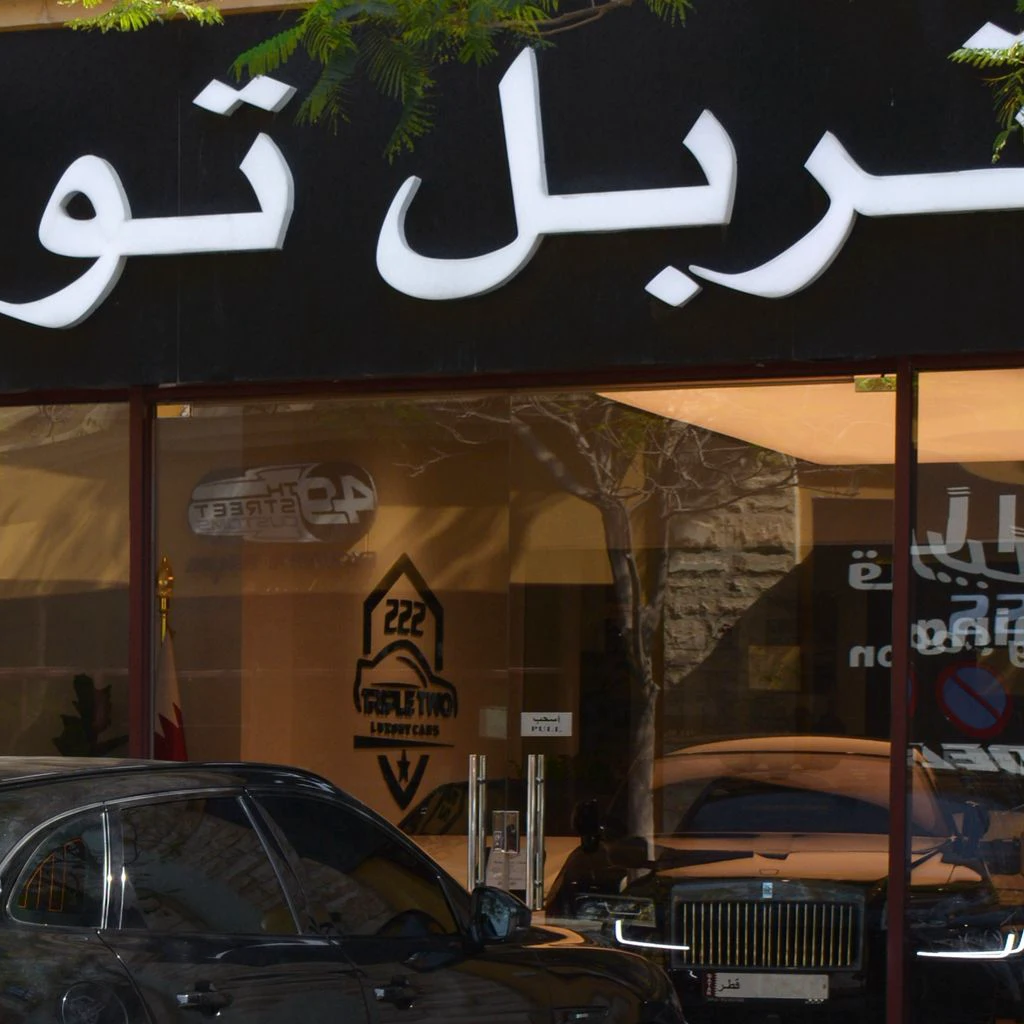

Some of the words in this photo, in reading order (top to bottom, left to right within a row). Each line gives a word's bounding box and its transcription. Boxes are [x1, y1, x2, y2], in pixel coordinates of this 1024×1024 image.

[384, 598, 427, 638] 222
[531, 725, 563, 733] PULL
[718, 978, 740, 992] قطر
